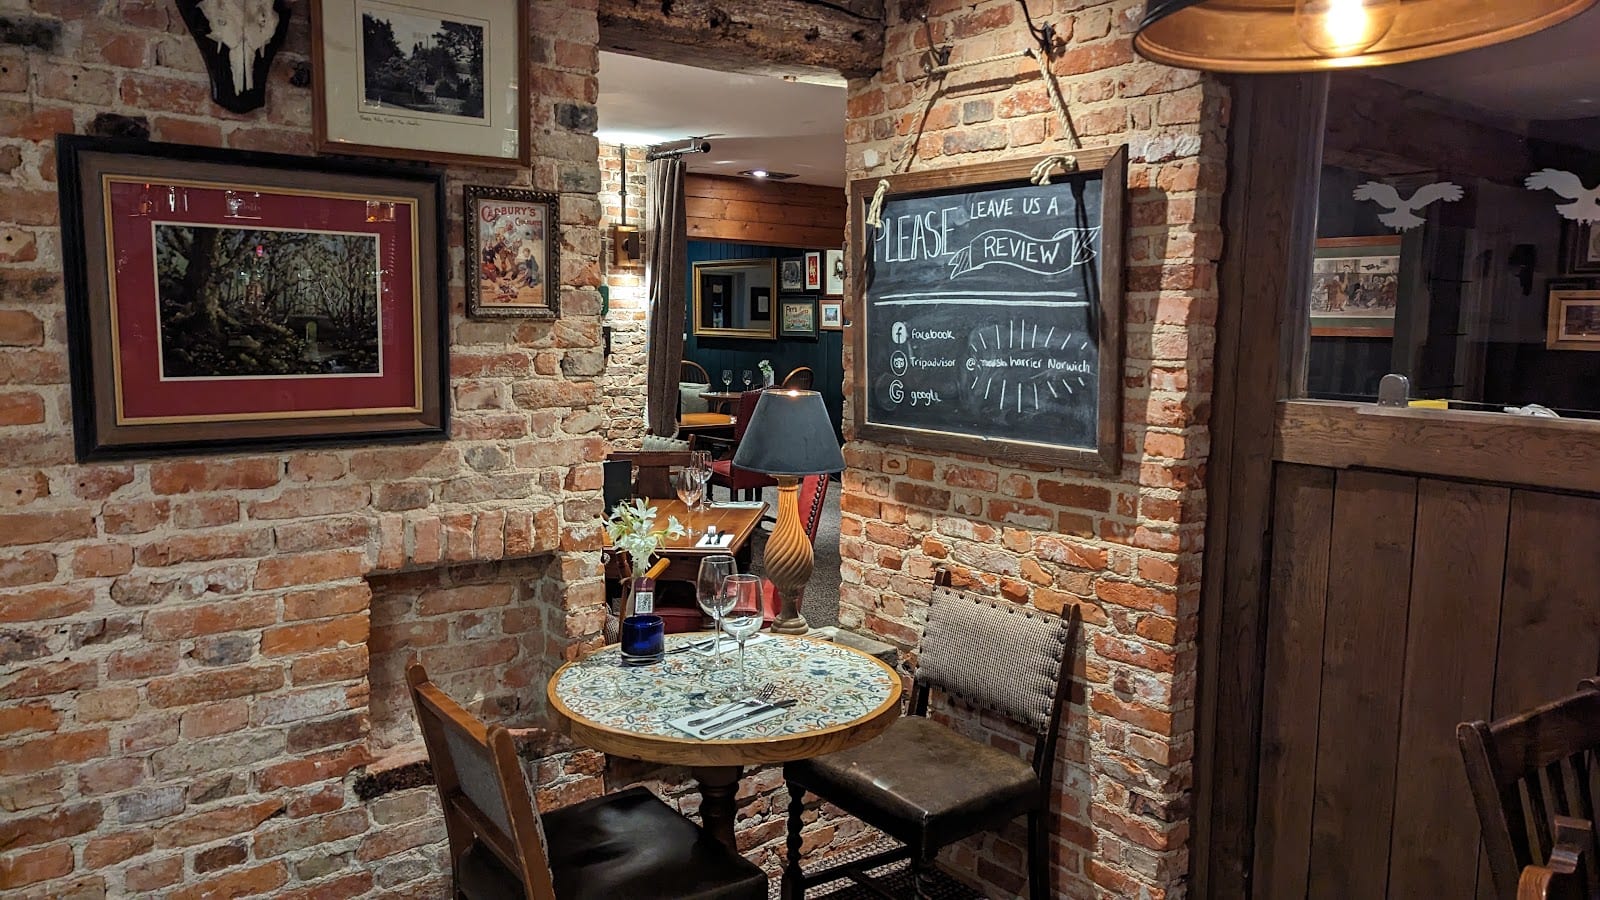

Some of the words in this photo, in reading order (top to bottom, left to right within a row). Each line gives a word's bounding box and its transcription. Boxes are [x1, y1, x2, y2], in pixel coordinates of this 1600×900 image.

[970, 198, 1014, 220] LEAVE
[1022, 197, 1041, 215] US
[1046, 197, 1059, 216] A
[873, 206, 959, 263] PLEASE
[984, 235, 1060, 265] REVIEW
[911, 328, 956, 340] facebook
[909, 356, 956, 370] Tripadvisor
[1009, 355, 1043, 369] harrier
[1048, 358, 1091, 374] Norwich
[910, 388, 943, 406] google
